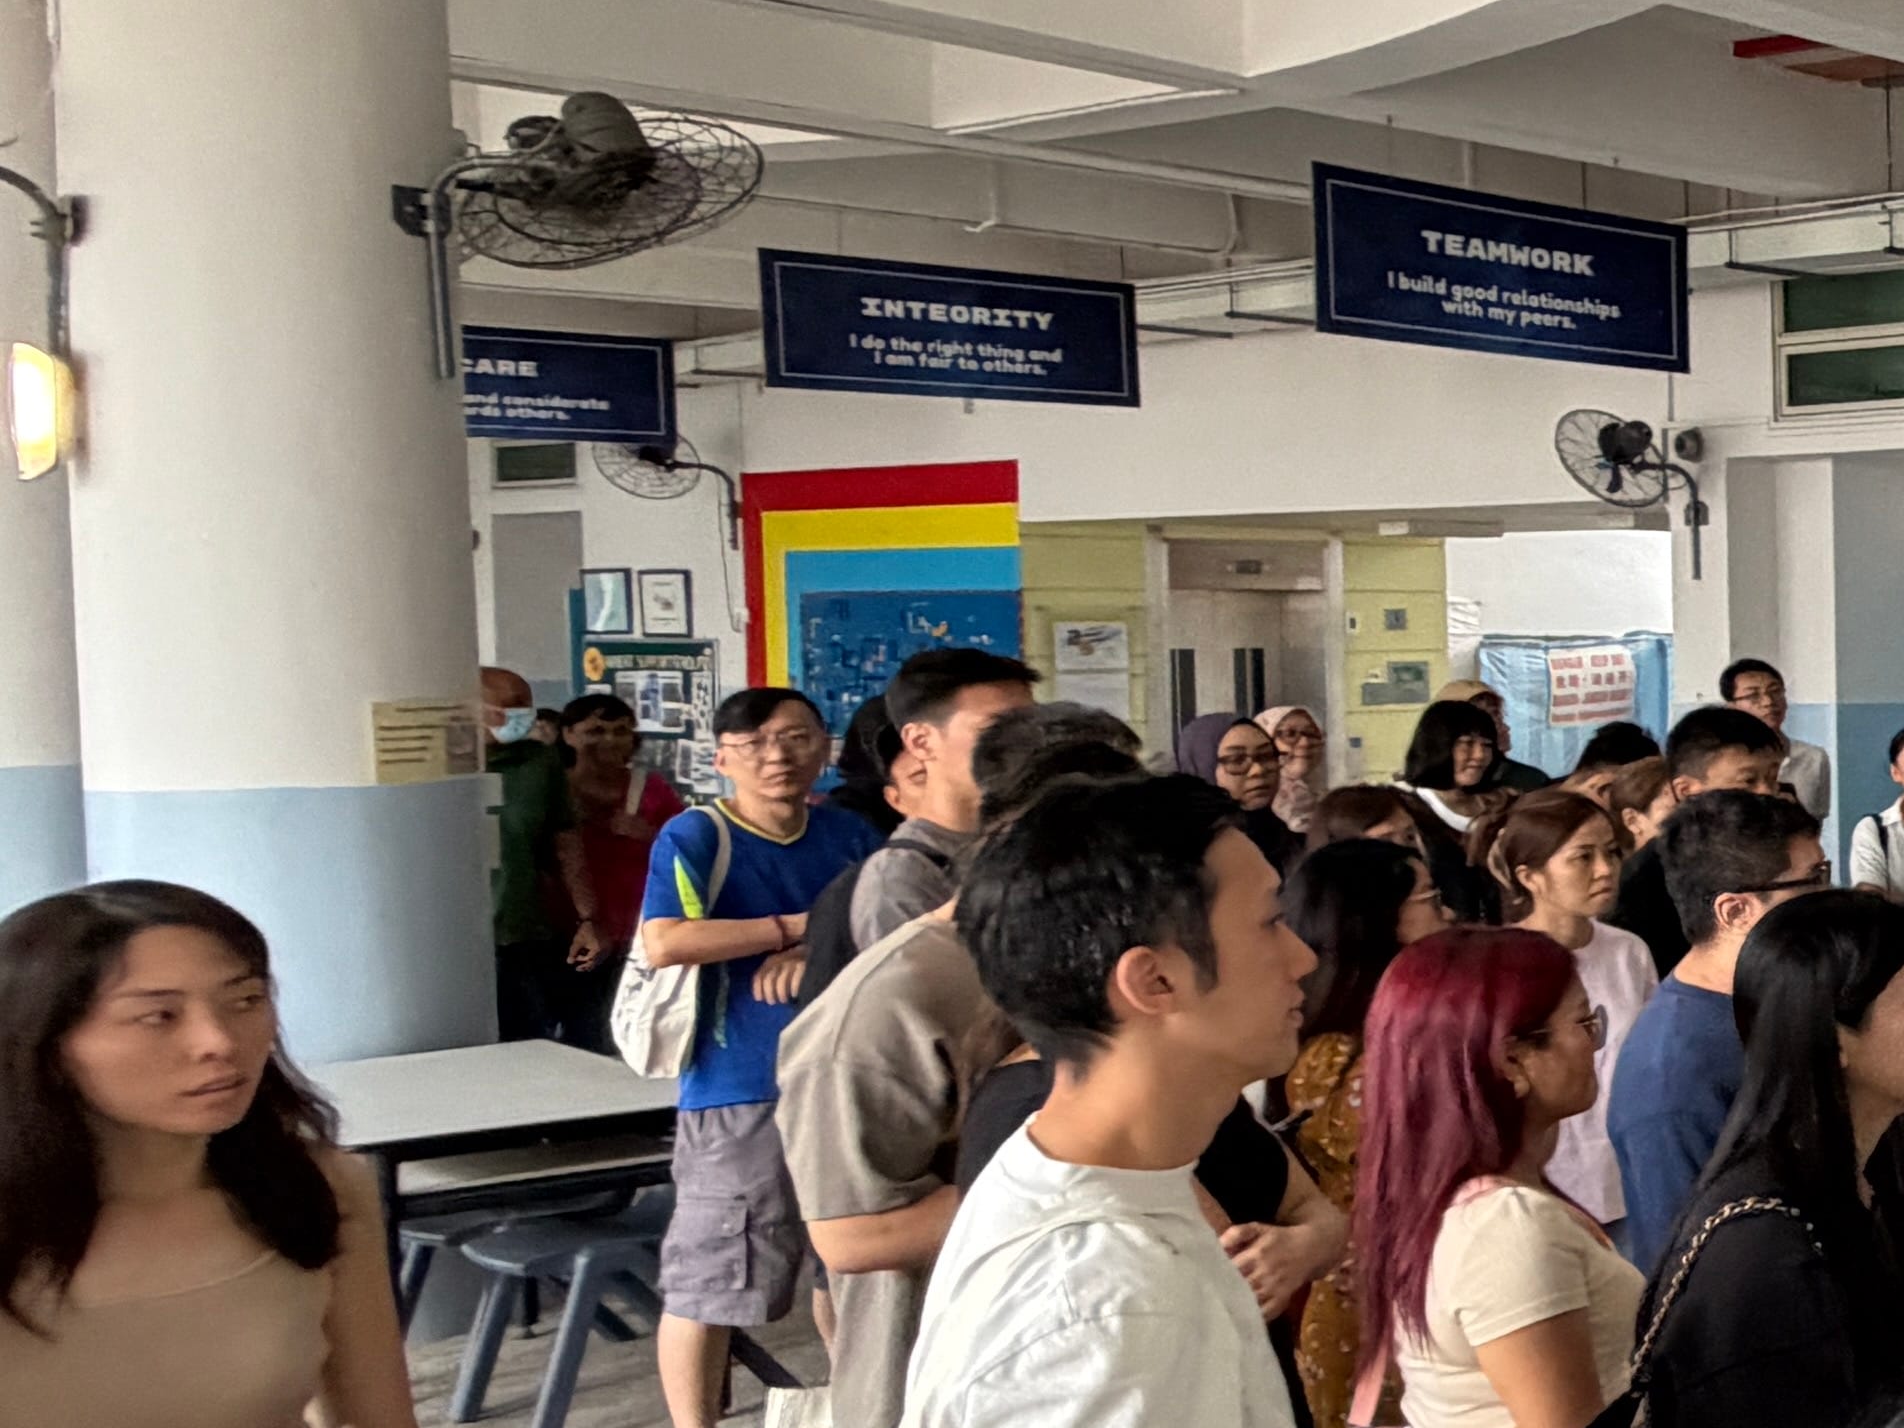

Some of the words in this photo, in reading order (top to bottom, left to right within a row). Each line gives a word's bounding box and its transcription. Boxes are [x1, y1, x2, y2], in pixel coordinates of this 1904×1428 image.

[1420, 230, 1596, 277] TEAMWORK
[1387, 271, 1394, 288] I
[1399, 272, 1447, 295] build
[1451, 283, 1498, 302] good
[1502, 289, 1621, 320] relationships
[1441, 299, 1483, 318] with
[1488, 306, 1516, 325] my
[1520, 310, 1577, 329] peers.
[861, 334, 886, 350] do
[890, 336, 923, 353] the
[927, 338, 974, 358] right
[977, 342, 1026, 363] thing
[1028, 347, 1063, 363] and
[885, 353, 915, 366] am
[919, 352, 952, 369] fair
[957, 356, 979, 370] to
[982, 357, 1048, 376] others.
